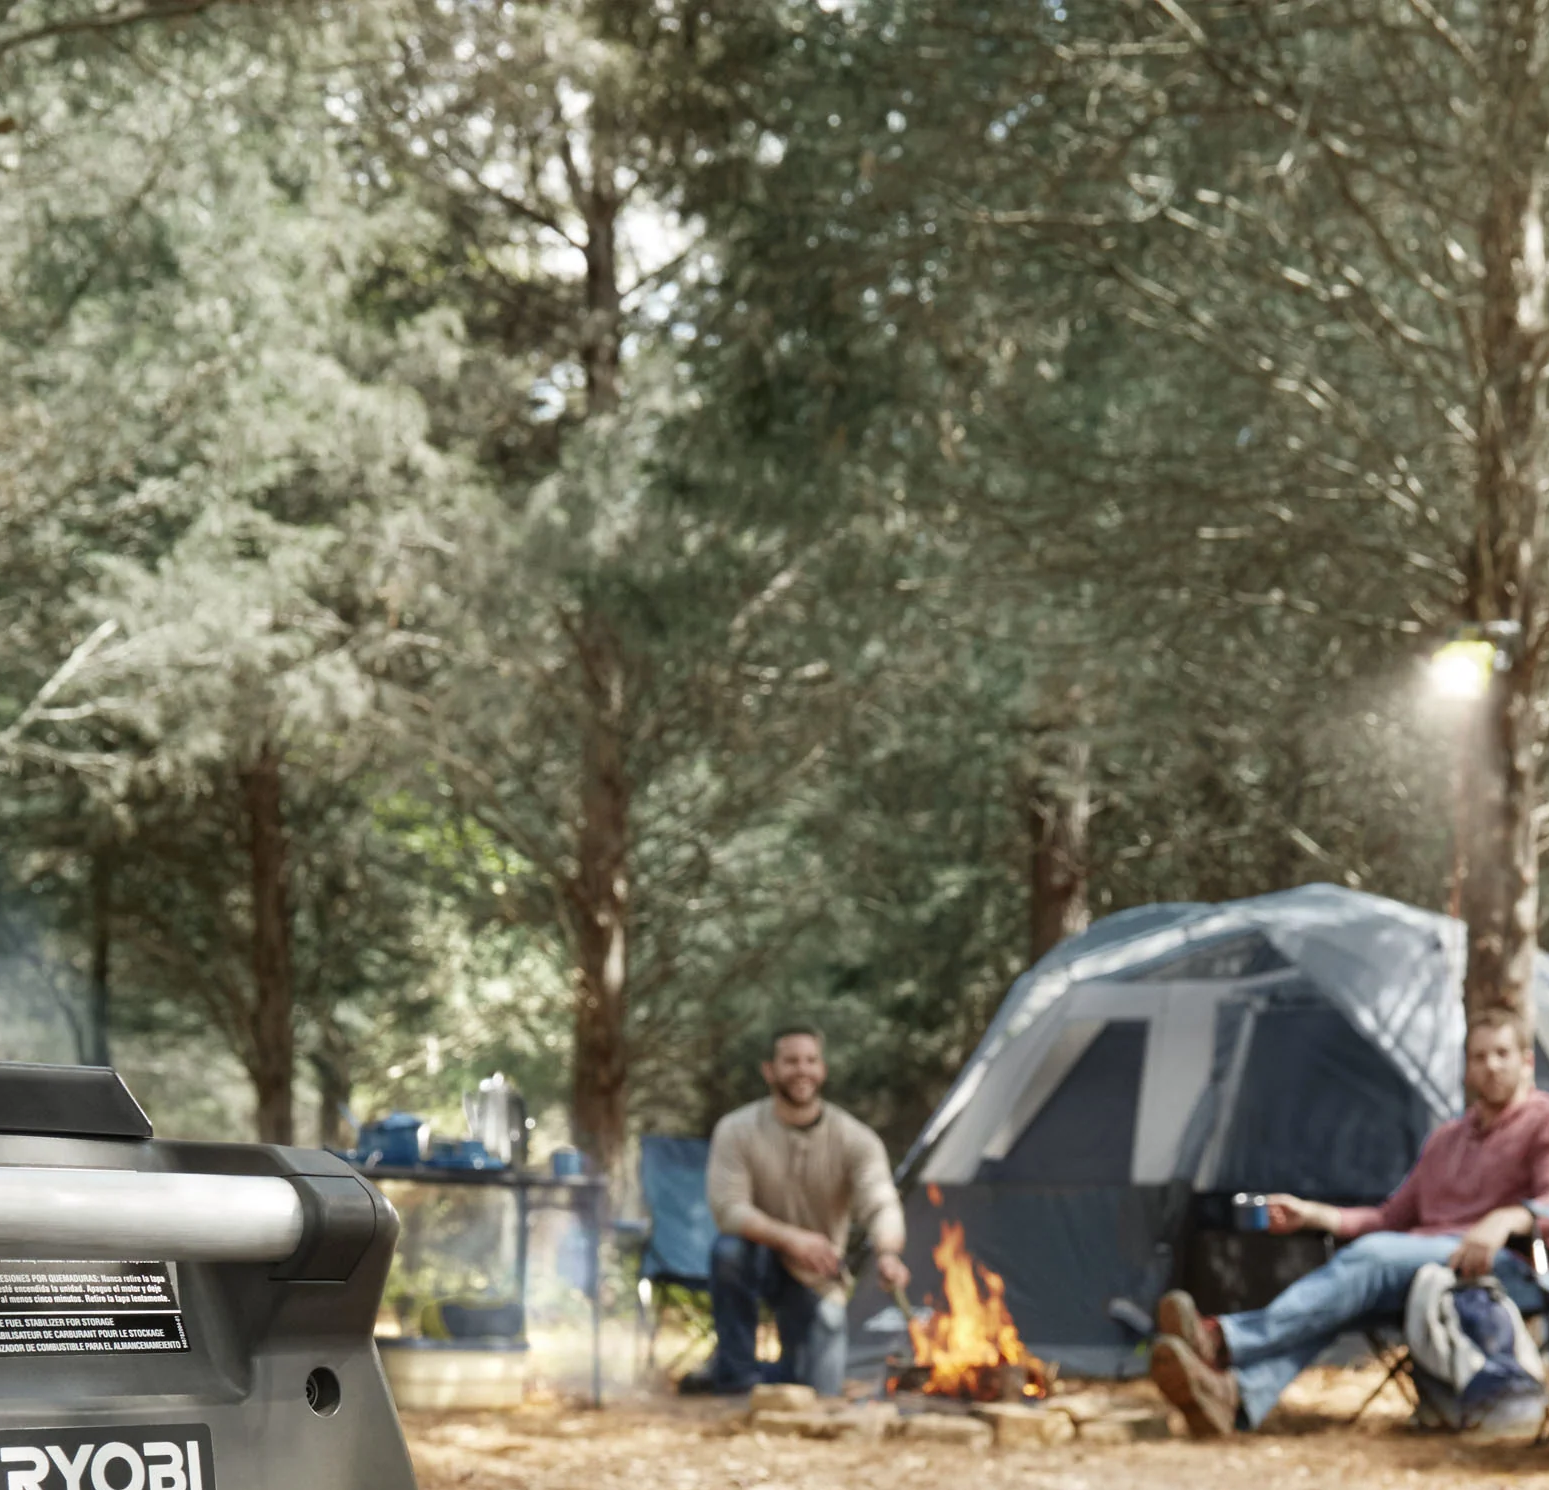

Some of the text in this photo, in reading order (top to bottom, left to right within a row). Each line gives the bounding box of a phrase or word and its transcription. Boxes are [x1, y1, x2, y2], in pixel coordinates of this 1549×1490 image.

[32, 1274, 47, 1282] POR
[14, 1285, 50, 1293] encendida
[87, 1285, 112, 1294] Apague
[121, 1285, 140, 1293] motor
[34, 1295, 53, 1303] cinco
[85, 1294, 106, 1303] Retire
[116, 1295, 130, 1304] tapa
[6, 1319, 24, 1328] FUEL
[24, 1318, 65, 1327] STABILIZER
[66, 1318, 81, 1326] FOR
[81, 1318, 114, 1326] STORAGE
[43, 1331, 53, 1339] DE
[55, 1330, 97, 1338] CARBURANT
[98, 1330, 119, 1338] POUR
[120, 1329, 128, 1338] LE
[129, 1329, 165, 1338] STOCKAGE
[26, 1343, 36, 1352] DE
[36, 1343, 85, 1352] COMBUSTIBLE
[85, 1342, 105, 1351] PARA
[105, 1342, 113, 1350] EL
